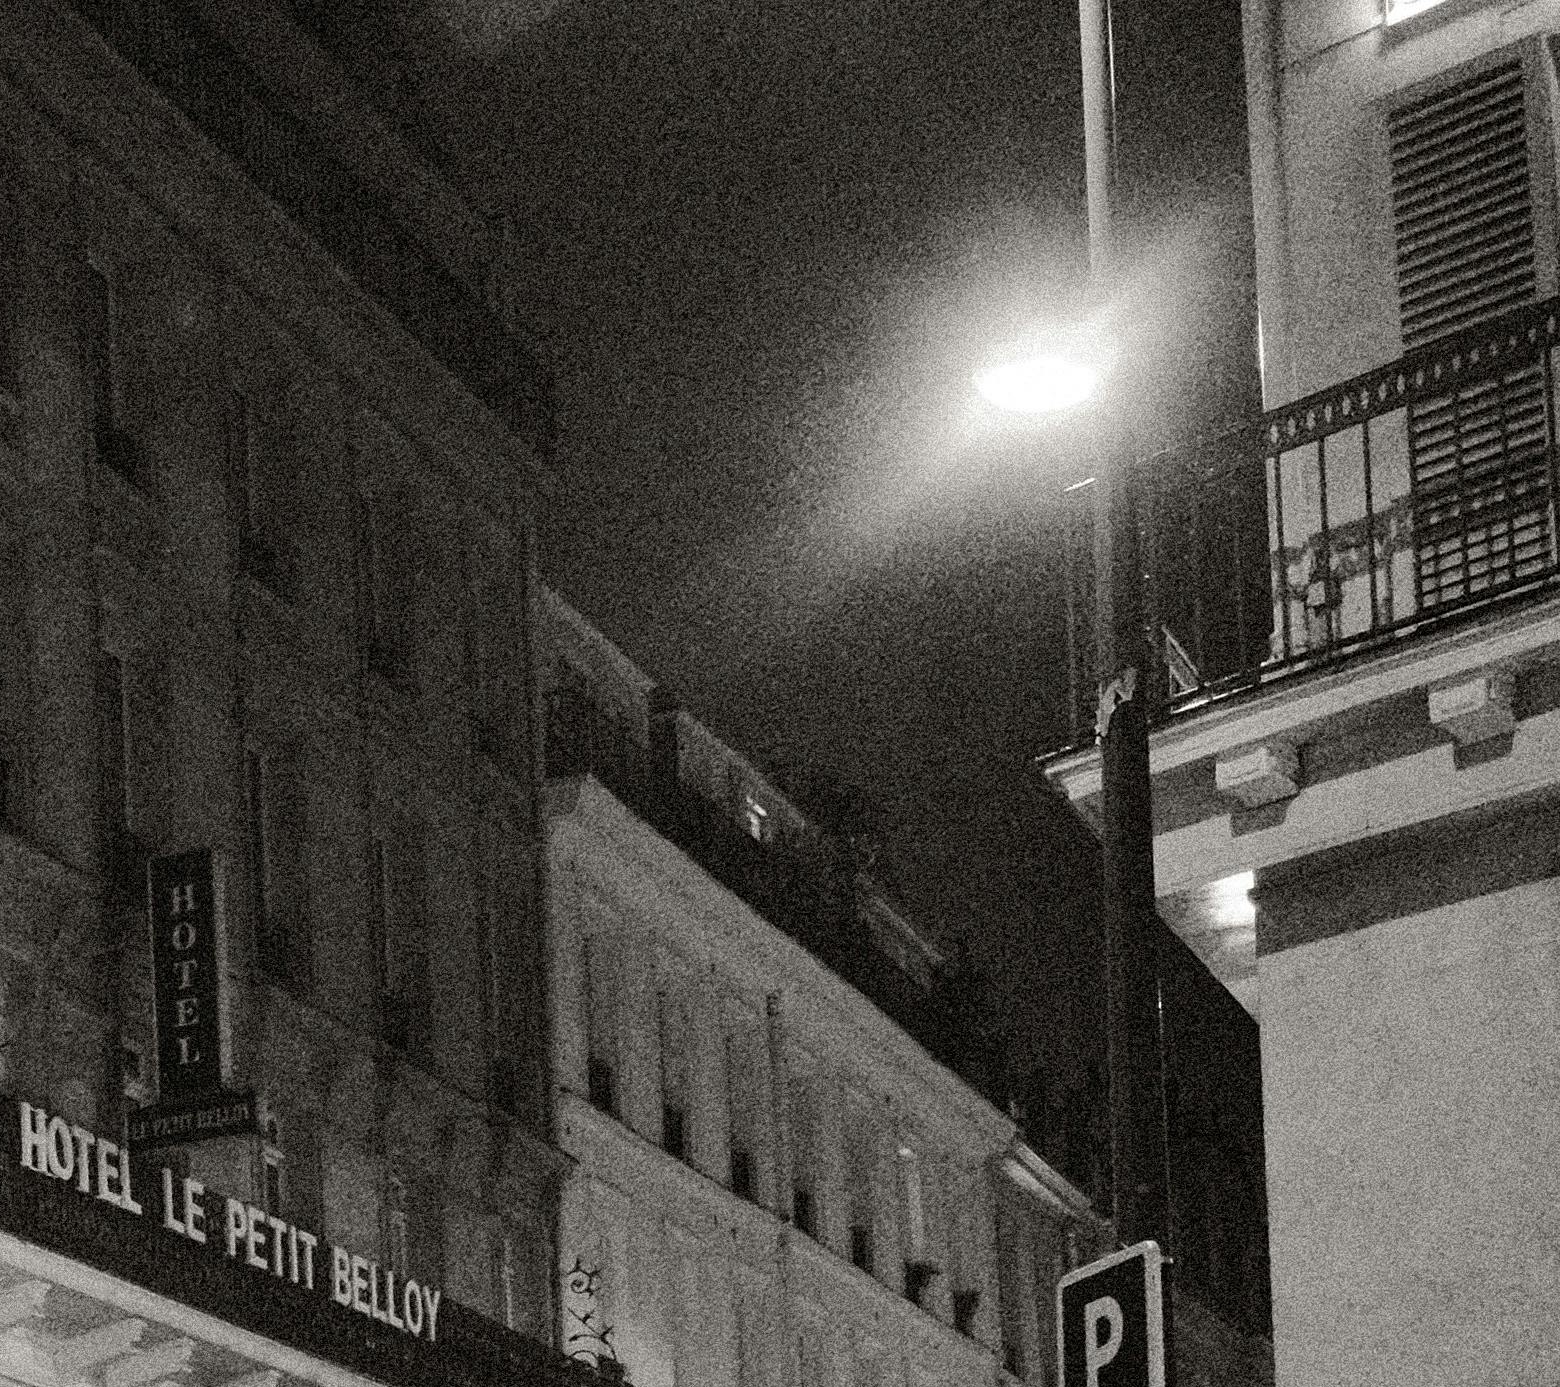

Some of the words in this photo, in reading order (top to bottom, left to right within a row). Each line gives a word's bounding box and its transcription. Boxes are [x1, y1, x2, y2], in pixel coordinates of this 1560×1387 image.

[171, 883, 200, 1067] HOTEL
[20, 1101, 143, 1216] HOTEL
[161, 1167, 207, 1244] LE
[225, 1197, 319, 1291] PETIT
[329, 1244, 441, 1342] BELLOY
